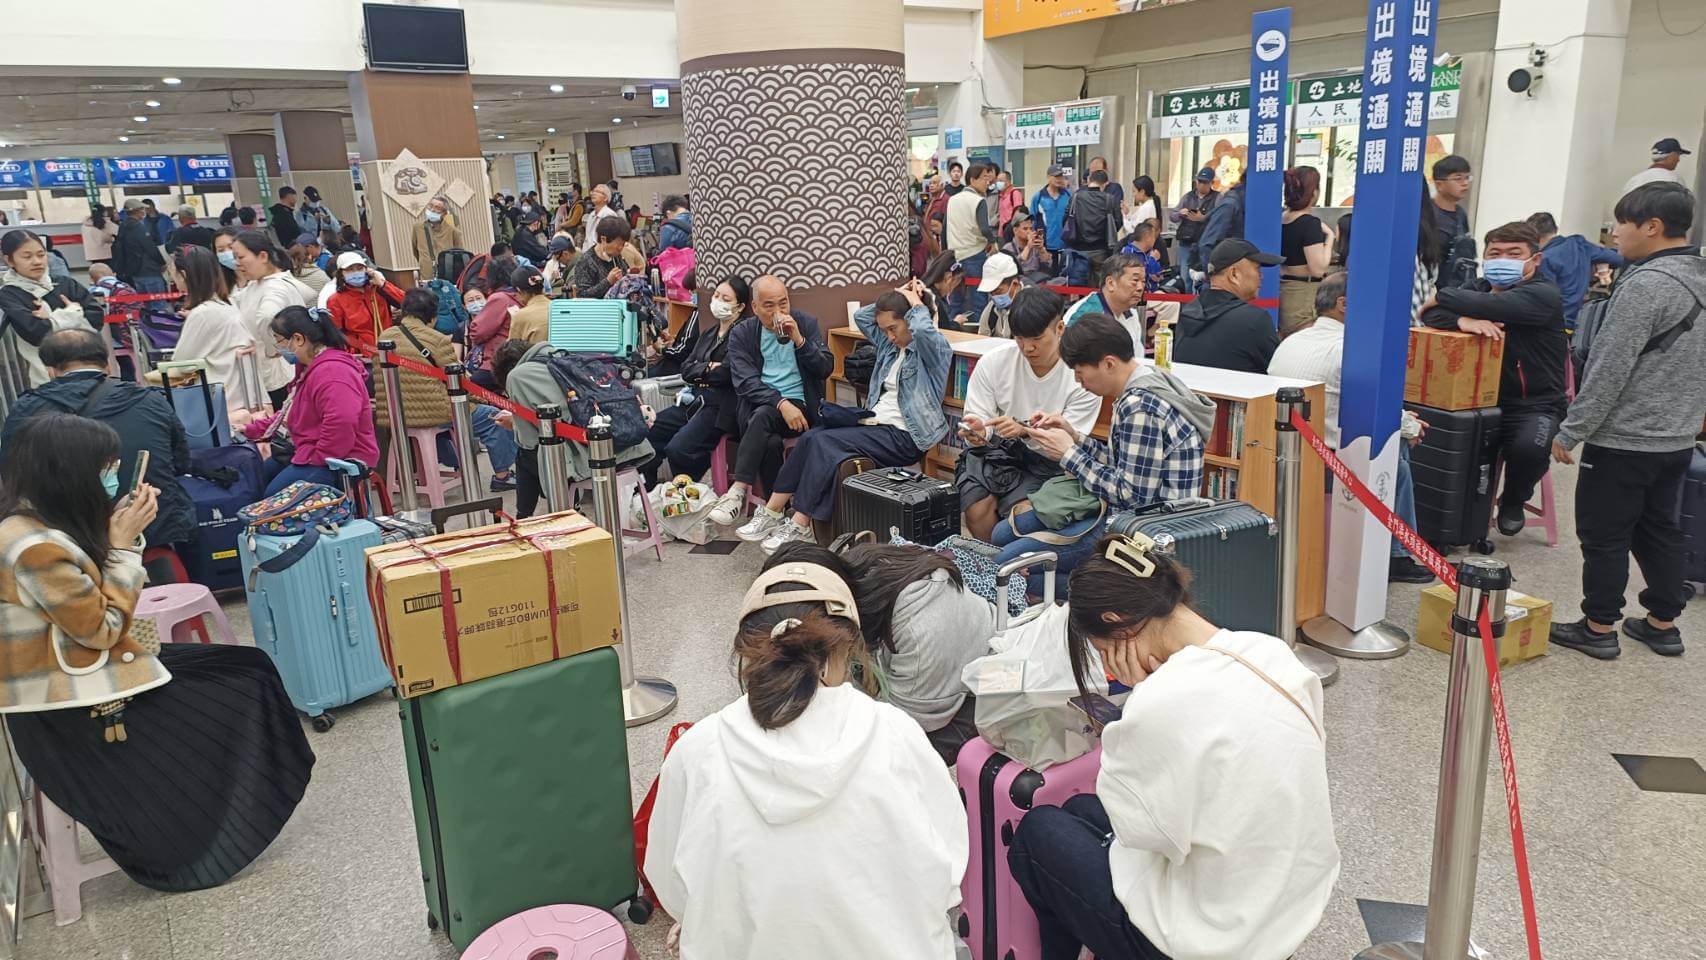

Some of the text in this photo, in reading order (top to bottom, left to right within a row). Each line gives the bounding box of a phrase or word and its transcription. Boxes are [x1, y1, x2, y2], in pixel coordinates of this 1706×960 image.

[1332, 79, 1363, 96] 土地
[1364, 2, 1396, 175] 出境通關
[1401, 0, 1431, 173] 出境通關
[1187, 91, 1241, 111] 土地銀行
[1309, 103, 1361, 118] 人民
[1171, 112, 1240, 128] 人民幣收
[1256, 70, 1280, 173] 出境通關
[488, 600, 535, 618] 110G12包
